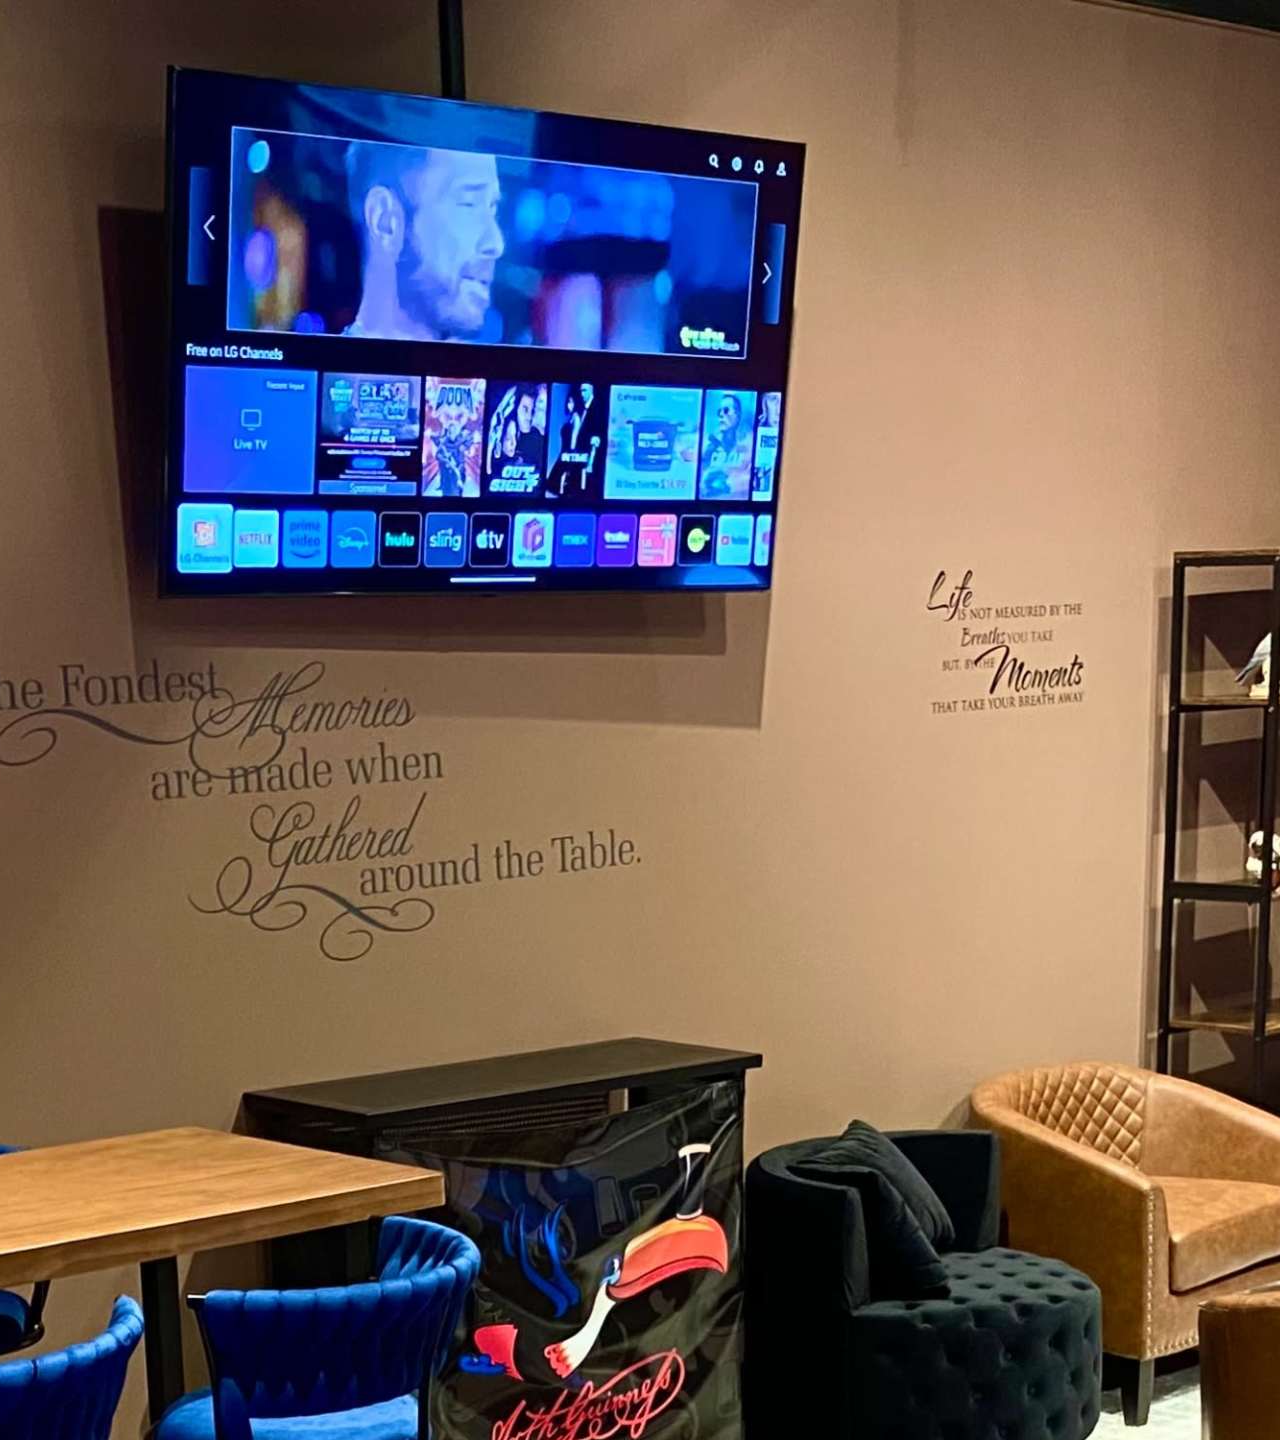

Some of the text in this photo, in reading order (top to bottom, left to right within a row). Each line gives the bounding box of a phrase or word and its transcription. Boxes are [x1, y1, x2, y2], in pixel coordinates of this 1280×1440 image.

[186, 342, 284, 361] Free on LG Channels
[233, 438, 267, 451] Live TV
[239, 533, 273, 545] NETFLIX
[385, 532, 415, 547] hulu
[429, 528, 462, 552] sling
[926, 570, 973, 622] Life
[970, 607, 992, 620] NOT
[995, 605, 1047, 619] MEASURED
[1049, 605, 1060, 617] BY
[1064, 603, 1082, 616] THE
[960, 627, 1053, 647] Breaths YOU TAKE
[974, 644, 1084, 695] Moments
[60, 661, 220, 707] Fondest
[931, 692, 1084, 714] THAT TAKE YOUR BREATH AWAY
[150, 741, 445, 801] are made when
[358, 831, 643, 897] around the Table.
